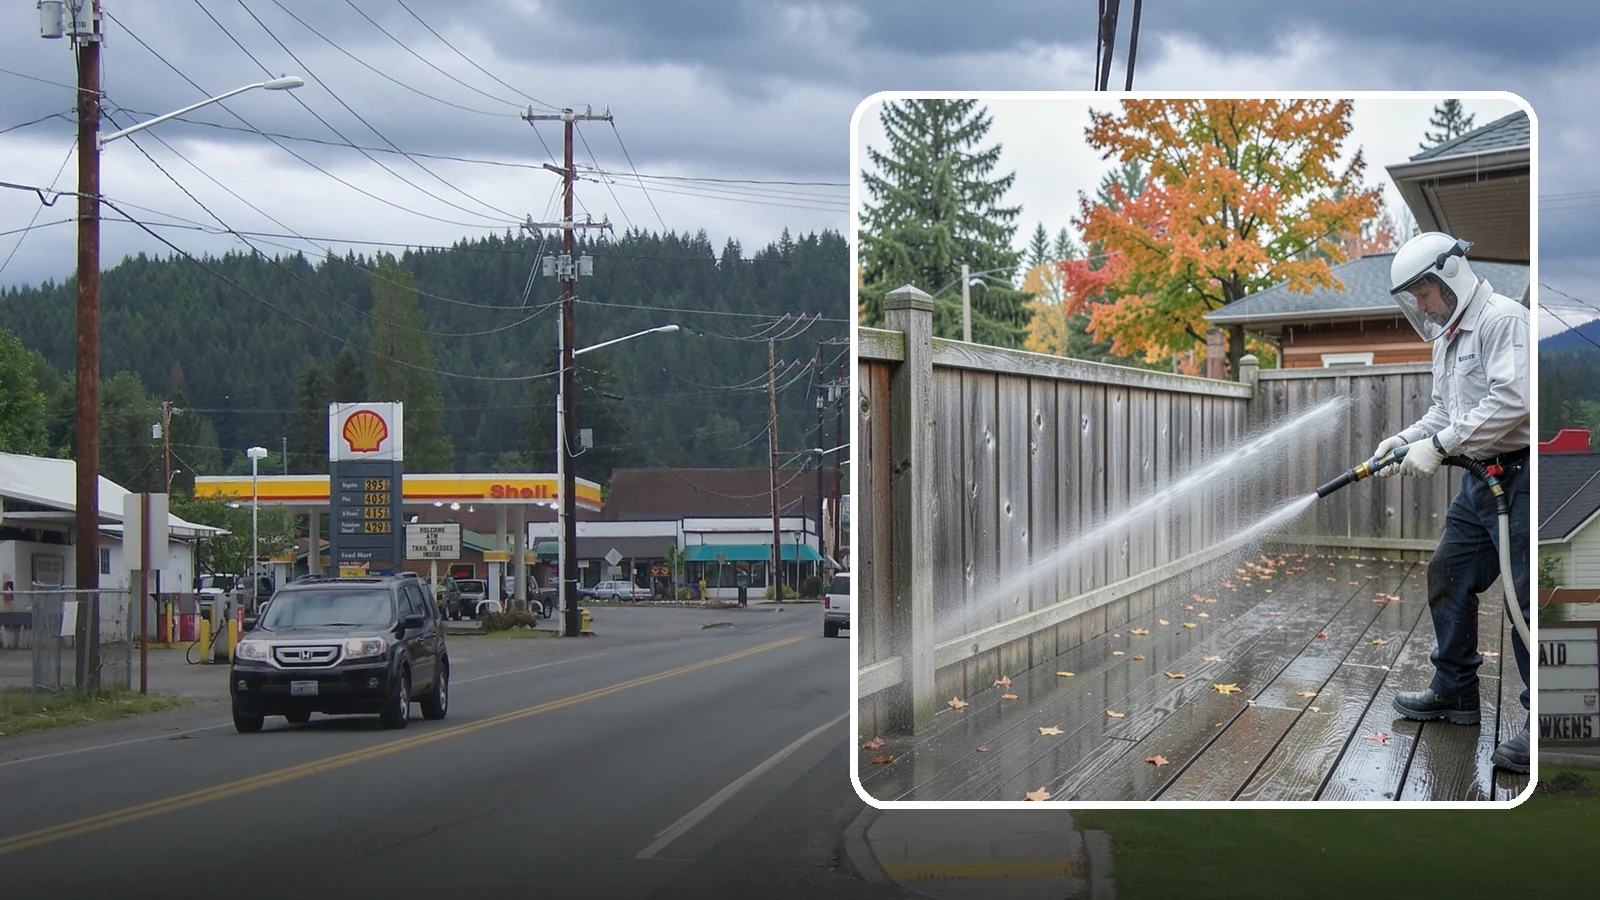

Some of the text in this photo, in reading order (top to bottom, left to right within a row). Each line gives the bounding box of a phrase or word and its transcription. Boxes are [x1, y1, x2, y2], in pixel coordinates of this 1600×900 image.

[365, 480, 383, 490] 395
[490, 484, 547, 499] Shell
[365, 494, 383, 504] 405
[365, 508, 383, 518] 415
[365, 522, 383, 533] 429
[1539, 643, 1566, 665] AID
